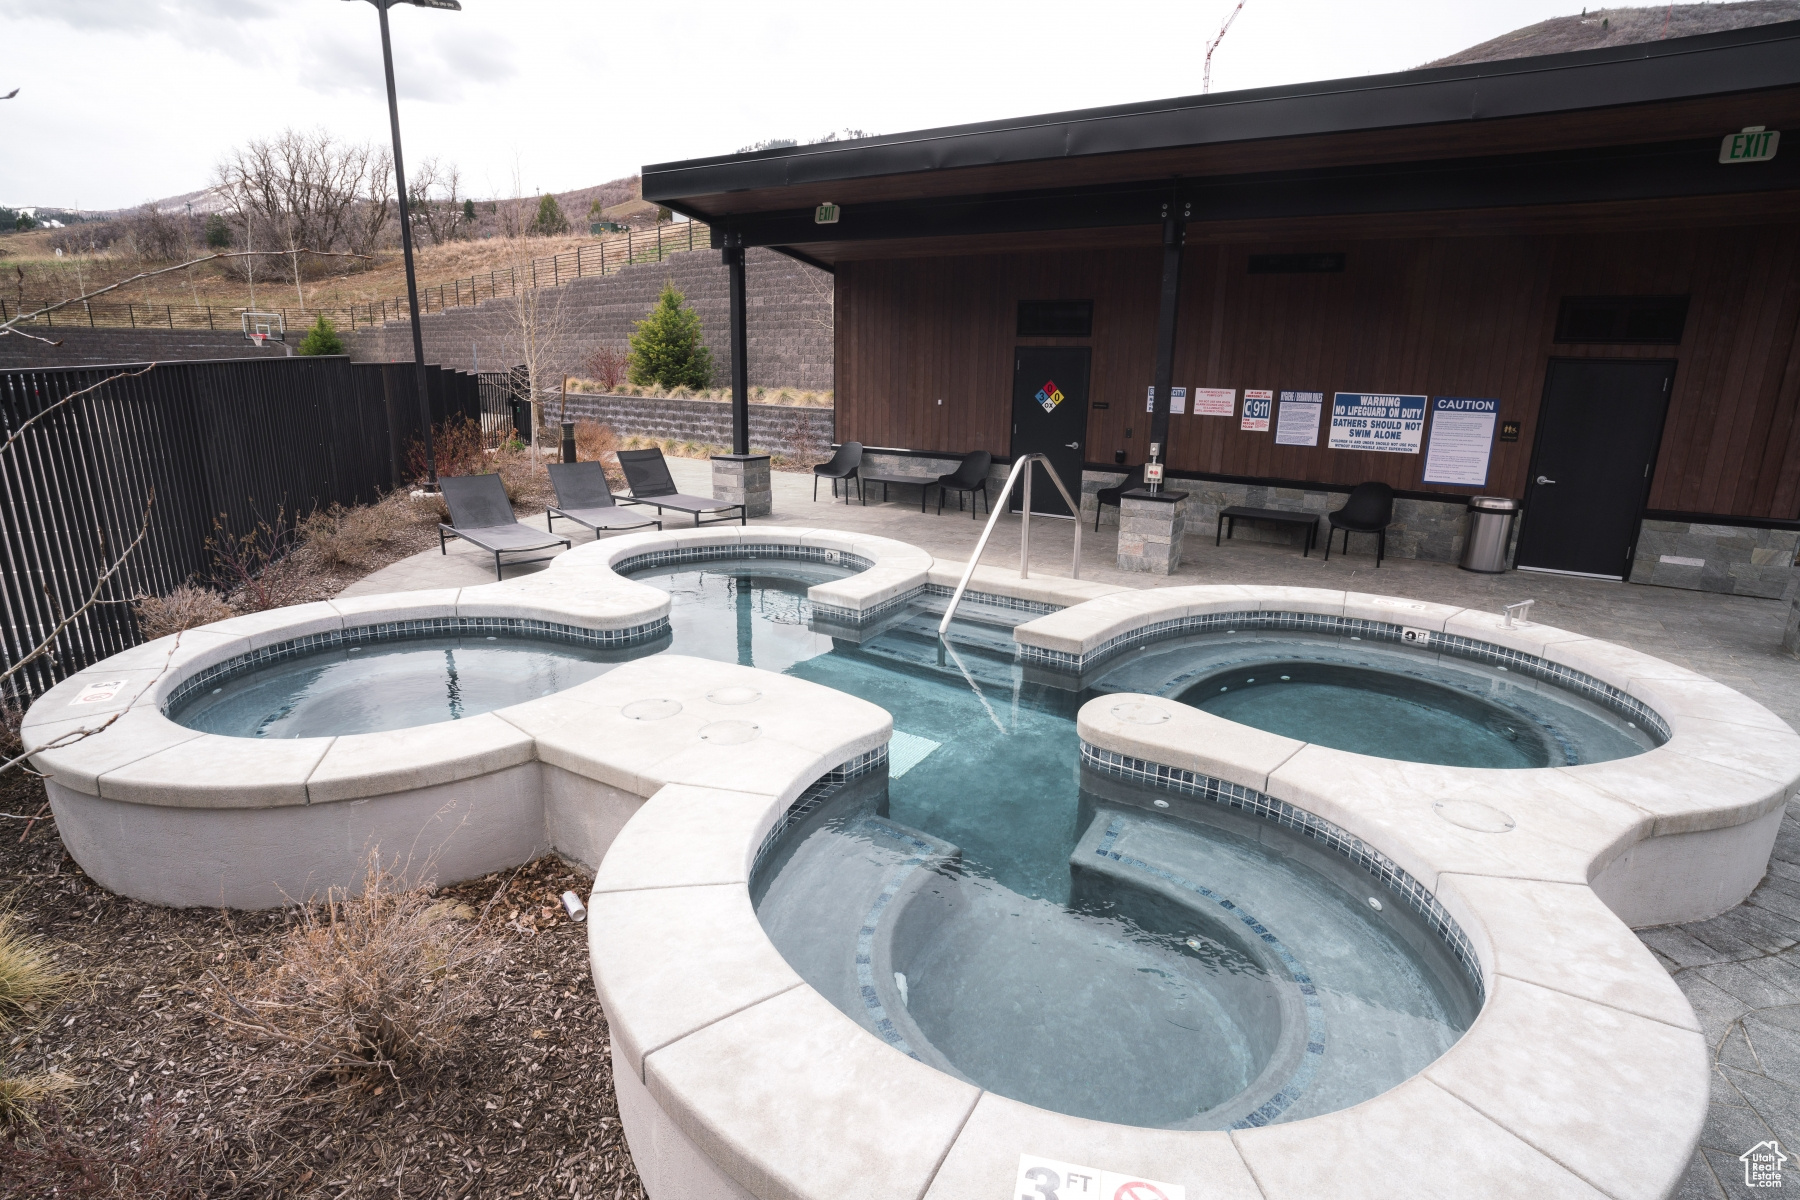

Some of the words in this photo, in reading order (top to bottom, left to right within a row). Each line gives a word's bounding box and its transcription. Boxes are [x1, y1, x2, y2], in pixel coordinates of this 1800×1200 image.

[1730, 132, 1773, 158] EXIT
[818, 206, 836, 221] EXIT
[1048, 384, 1052, 392] 0
[1054, 393, 1060, 401] 0
[1360, 396, 1400, 407] WARNING
[1253, 401, 1268, 416] 911
[1335, 405, 1345, 415] NO
[1348, 406, 1386, 417] LIFEGUARD
[1389, 408, 1398, 418] ON
[1402, 408, 1422, 418] DUTY
[1437, 400, 1494, 410] CAUTION
[1333, 418, 1367, 428] BATHERS
[1371, 420, 1401, 430] SHOULD
[1405, 422, 1421, 431] NOT
[1349, 429, 1371, 438] SWIM
[1374, 430, 1401, 439] ALONE
[1022, 1166, 1060, 1200] 3
[1066, 1172, 1092, 1192] FT
